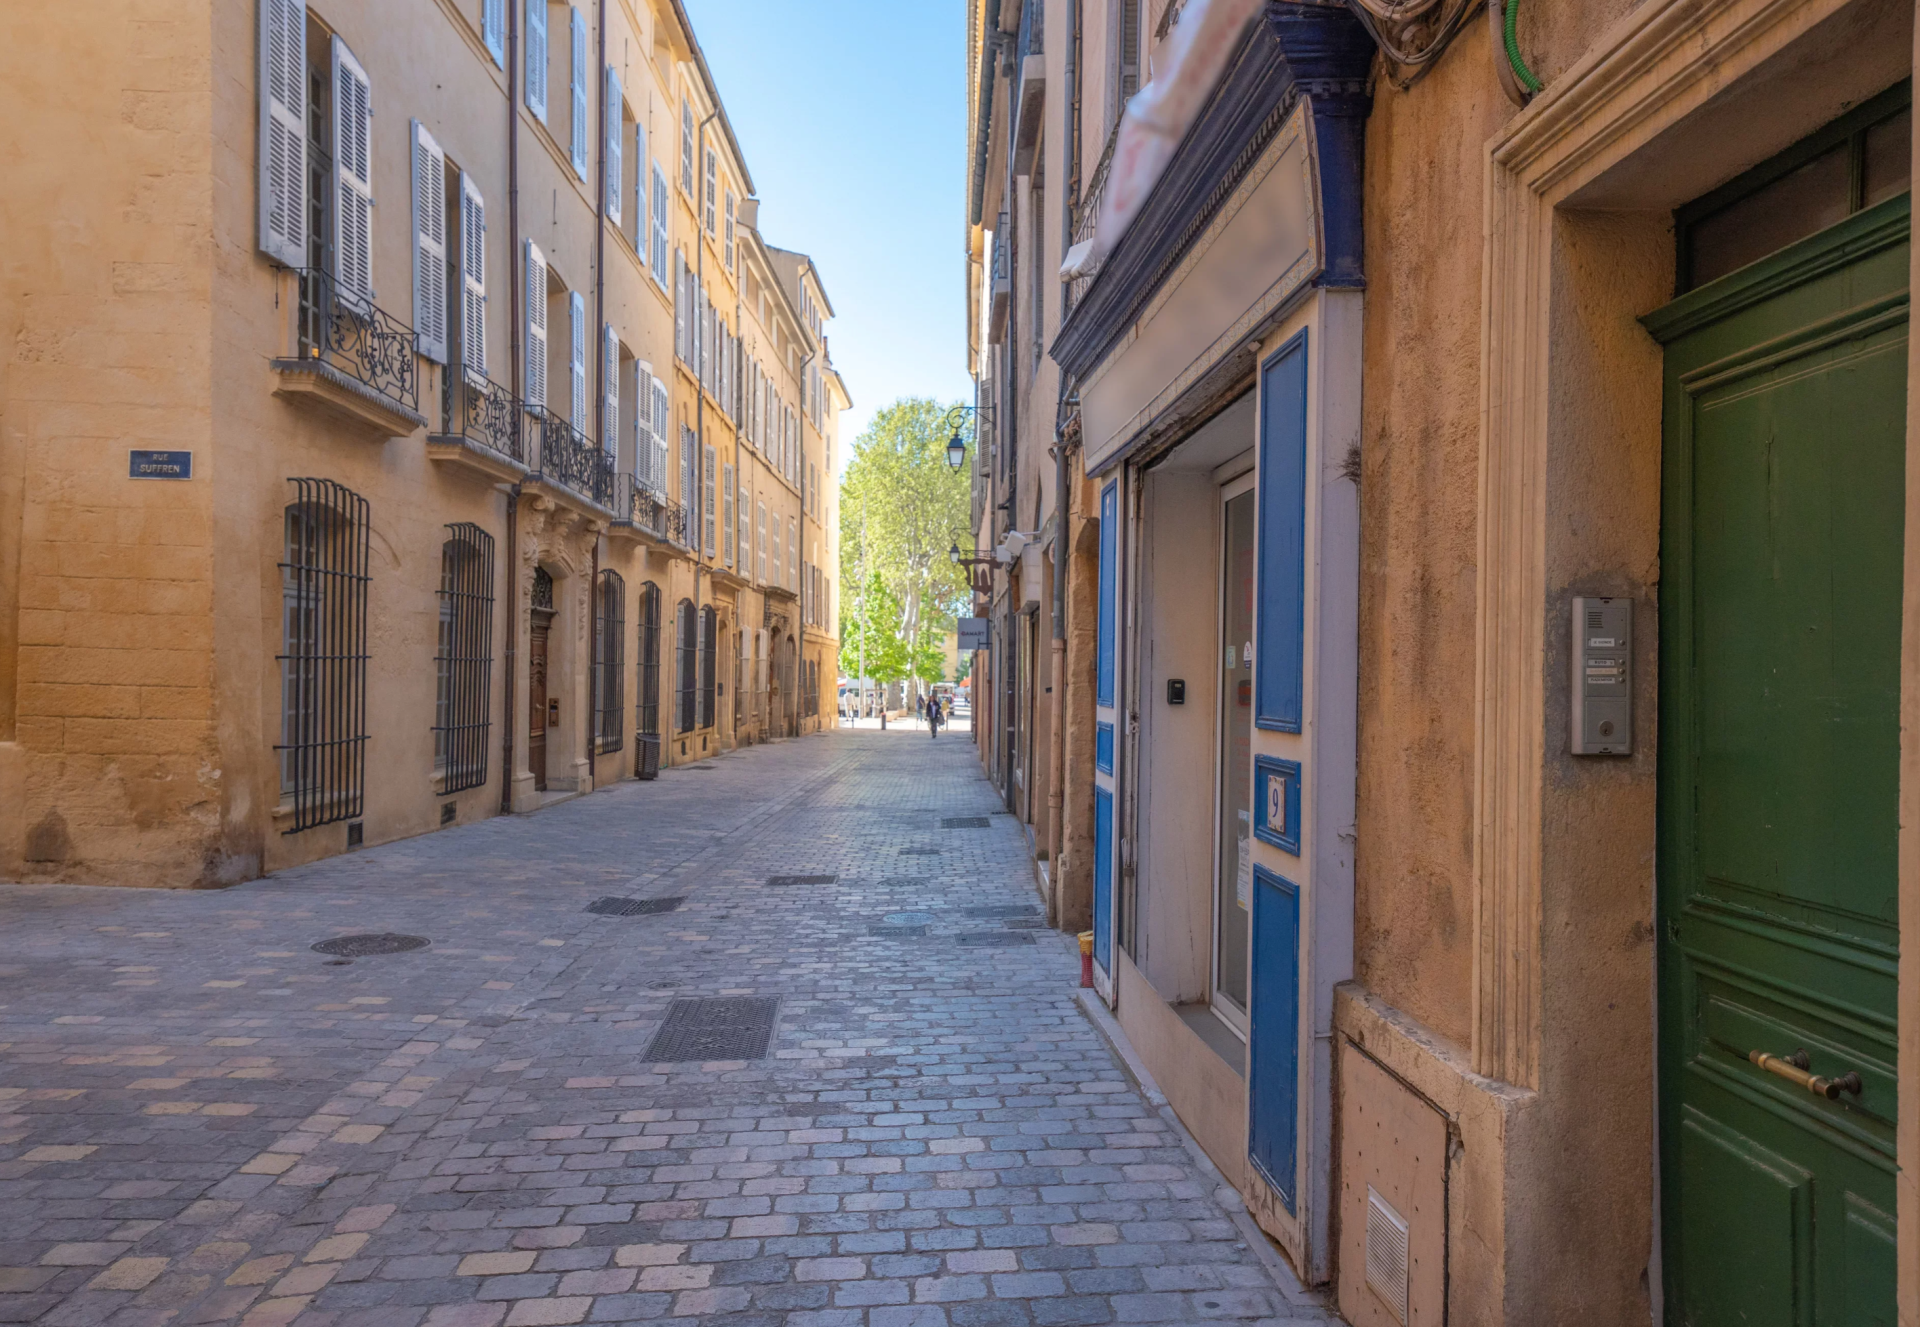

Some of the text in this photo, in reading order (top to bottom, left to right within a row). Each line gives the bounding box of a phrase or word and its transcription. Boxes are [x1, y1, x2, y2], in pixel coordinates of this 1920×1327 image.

[152, 453, 169, 461] RUE
[140, 464, 180, 473] SUFFREN
[1272, 788, 1279, 818] 9
